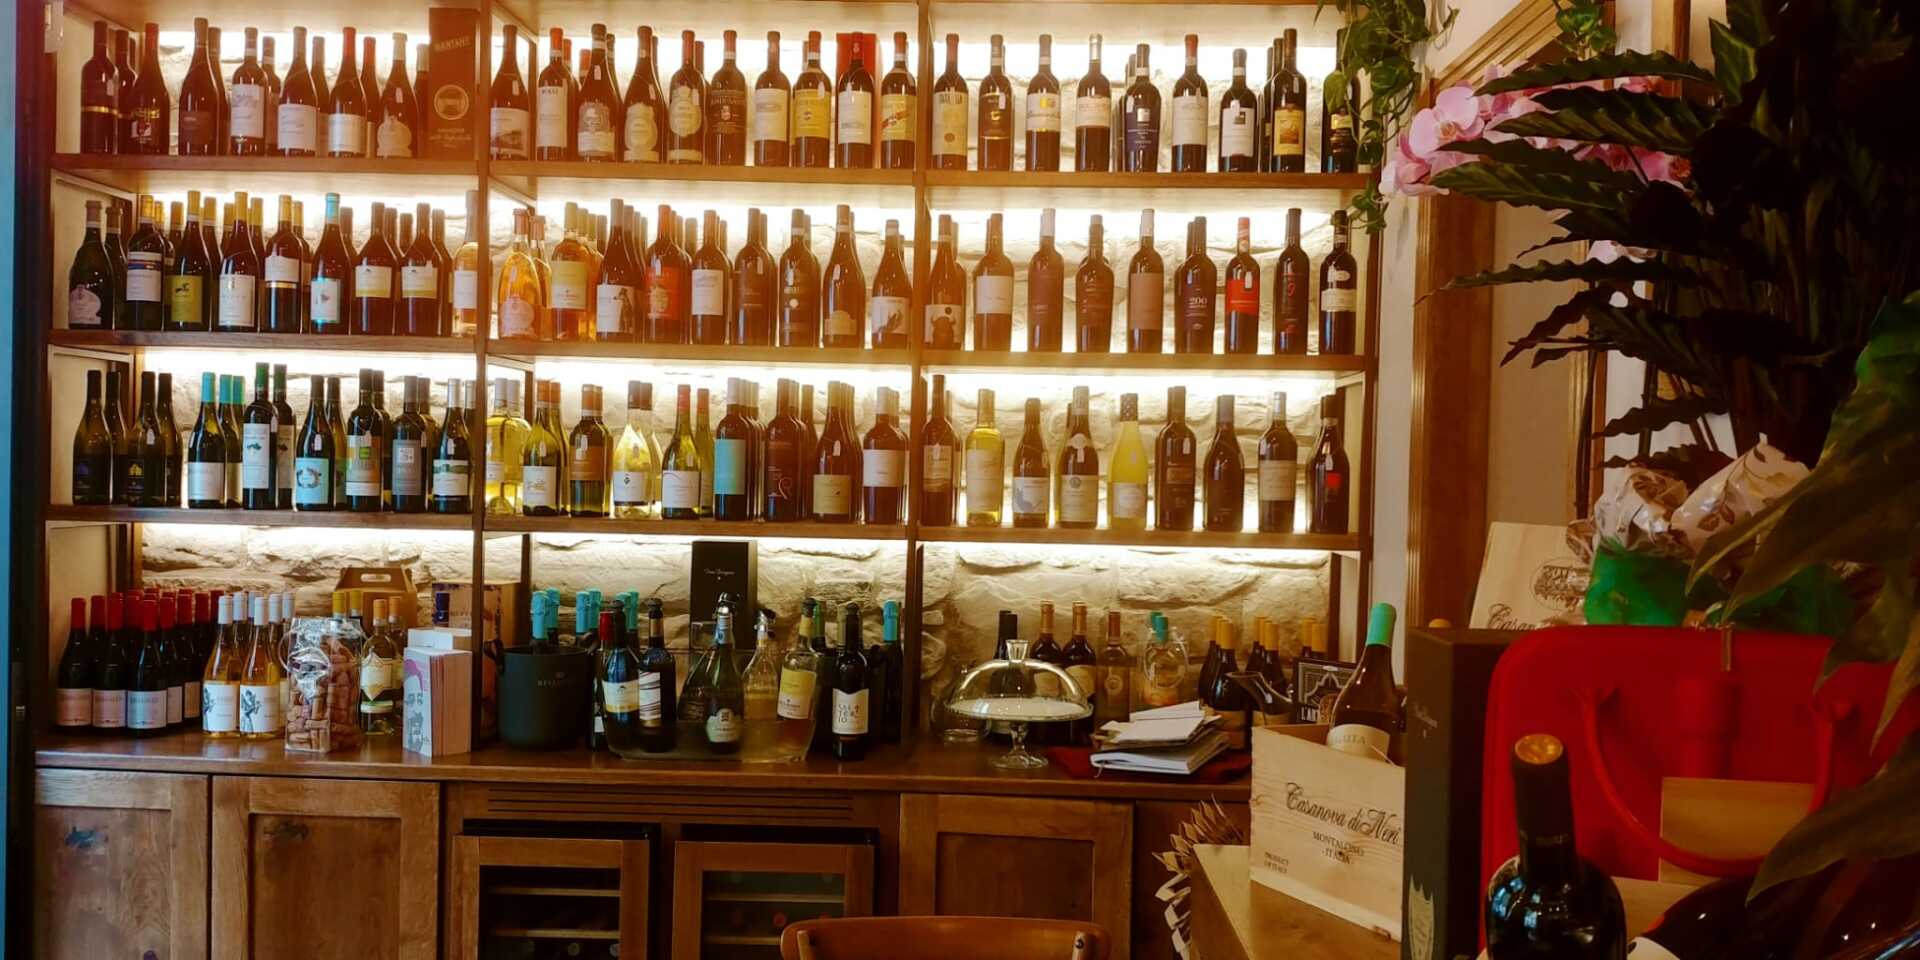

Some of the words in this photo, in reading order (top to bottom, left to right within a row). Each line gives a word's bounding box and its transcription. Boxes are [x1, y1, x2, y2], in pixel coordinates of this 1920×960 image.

[1286, 782, 1346, 827] Casanova
[1347, 808, 1362, 833] di
[1360, 808, 1402, 845] Neri
